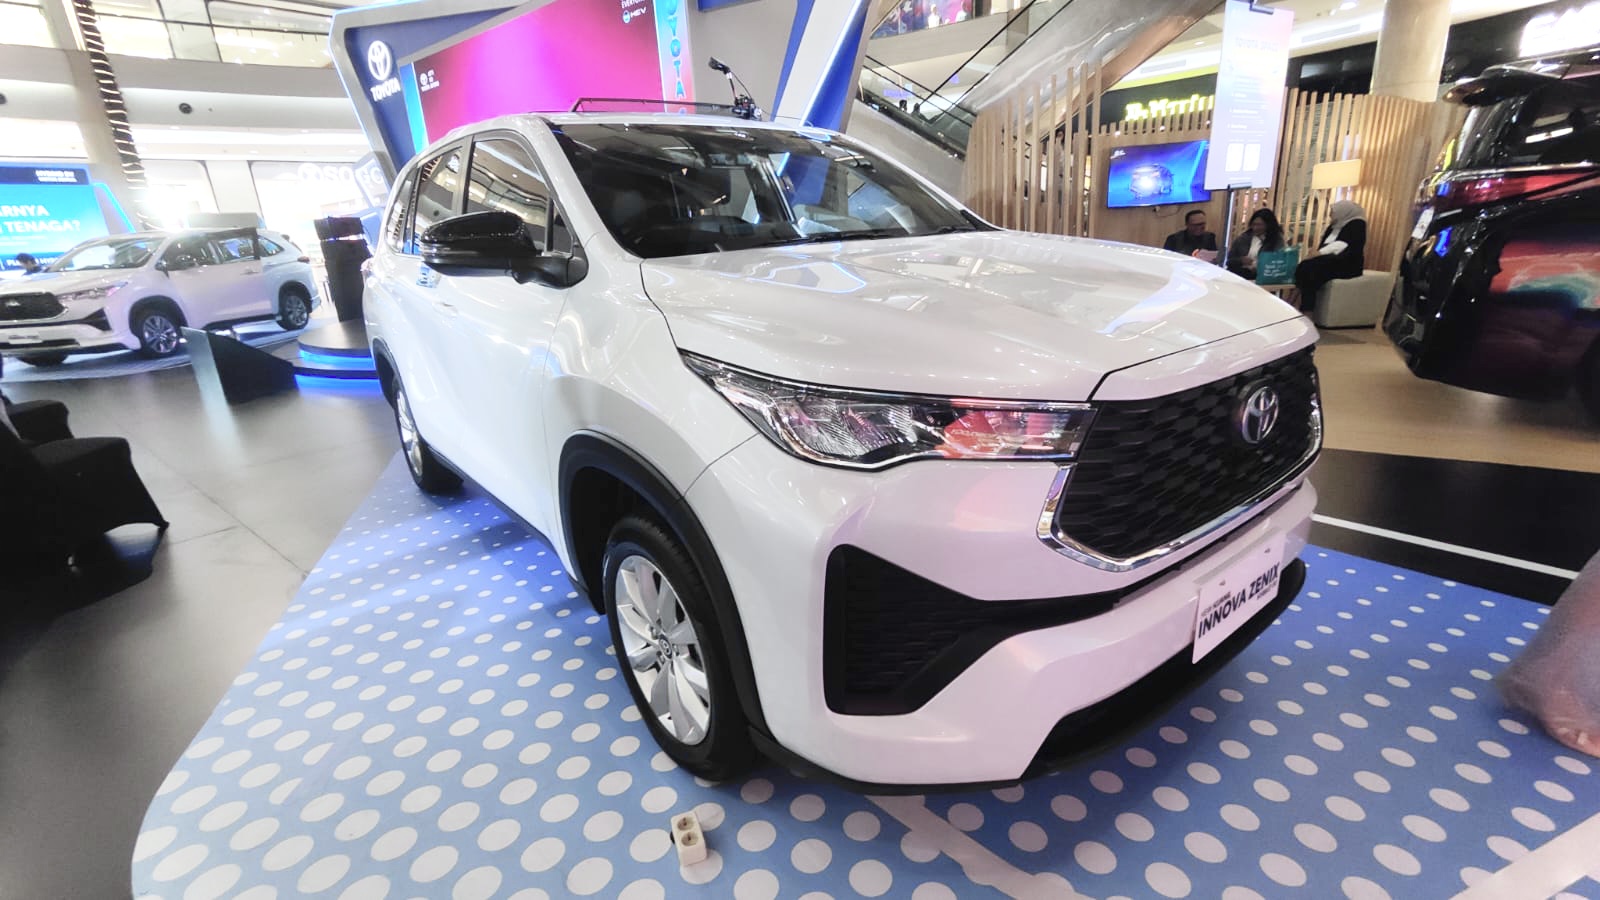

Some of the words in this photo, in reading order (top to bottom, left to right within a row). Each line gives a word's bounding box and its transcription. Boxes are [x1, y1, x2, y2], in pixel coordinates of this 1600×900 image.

[630, 7, 647, 18] HEV
[370, 77, 401, 102] TOYOTA
[0, 205, 50, 217] RNYA
[4, 219, 81, 233] TENAGA?
[1198, 589, 1246, 639] INNOVA
[1248, 562, 1280, 600] ZENIX
